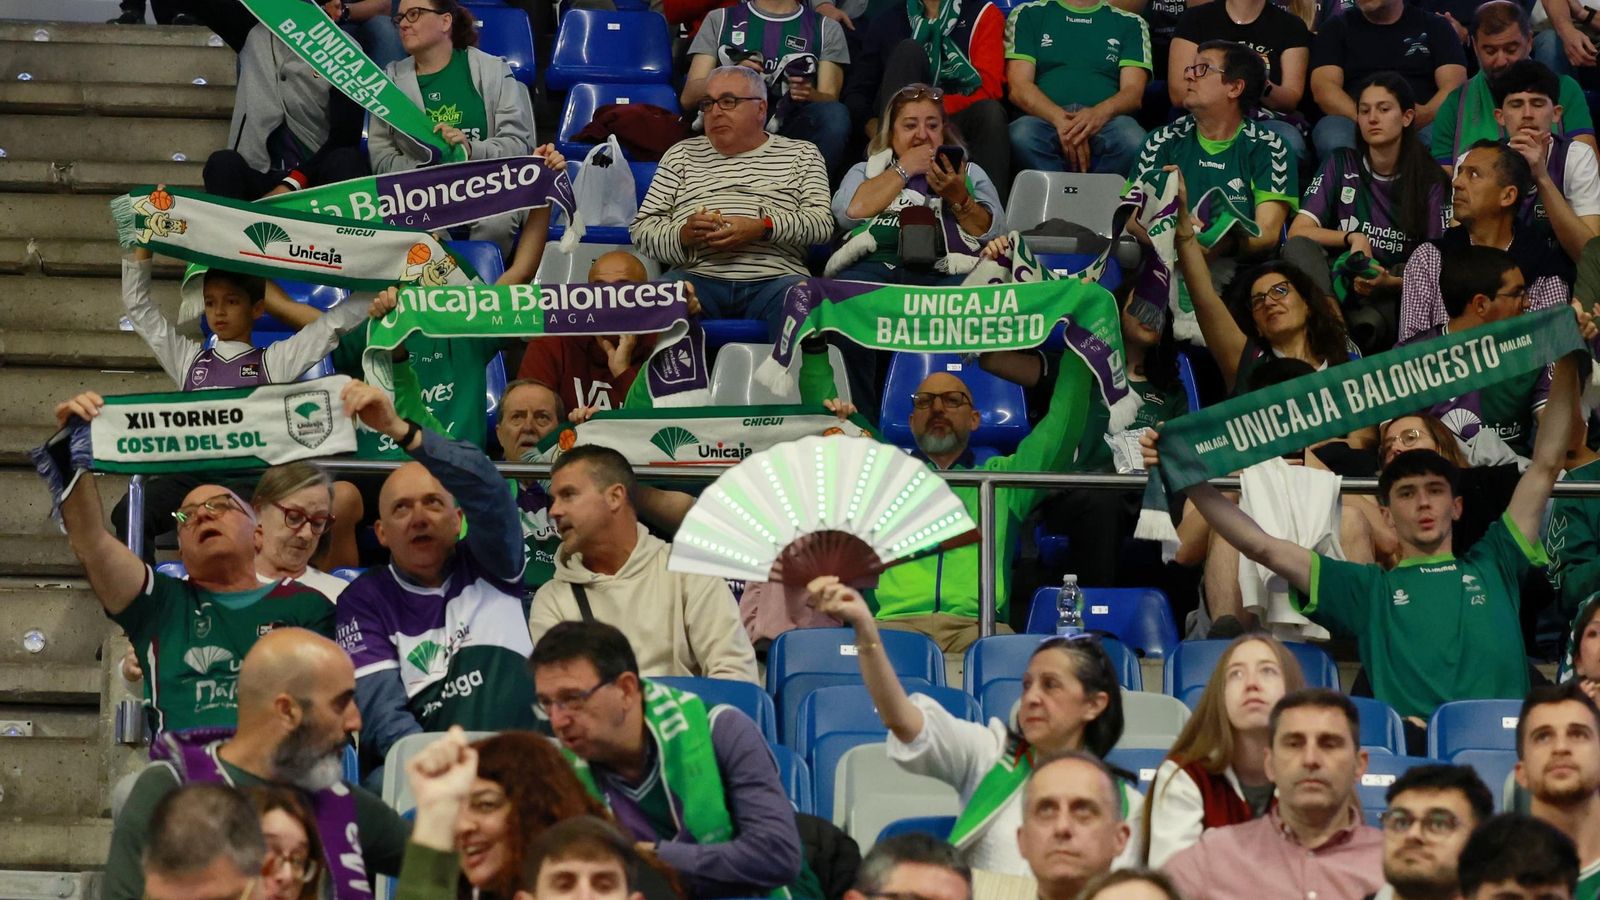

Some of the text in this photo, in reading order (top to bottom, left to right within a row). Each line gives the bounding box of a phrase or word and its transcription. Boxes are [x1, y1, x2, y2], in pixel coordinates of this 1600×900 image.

[1066, 16, 1092, 25] hummel
[278, 18, 390, 118] BALONCESTO
[307, 20, 390, 98] UNICAJA
[1198, 159, 1225, 170] hummel
[350, 164, 541, 221] Baloncesto
[336, 227, 376, 238] CHICUI
[289, 244, 343, 265] Unicaja
[509, 280, 687, 312] Baloncest
[903, 288, 1019, 316] UNICAJA
[491, 312, 596, 326] MÁLAGA
[876, 313, 1044, 346] BALONCESTO
[1195, 334, 1533, 455] MALAGA UNICAJA BALONCESTO MALAGA
[125, 407, 244, 430] XII TORNEO
[743, 417, 784, 427] CHICUI
[117, 431, 267, 455] COSTA DEL SOL
[698, 441, 753, 460] Unicaja
[1420, 564, 1456, 574] hummel
